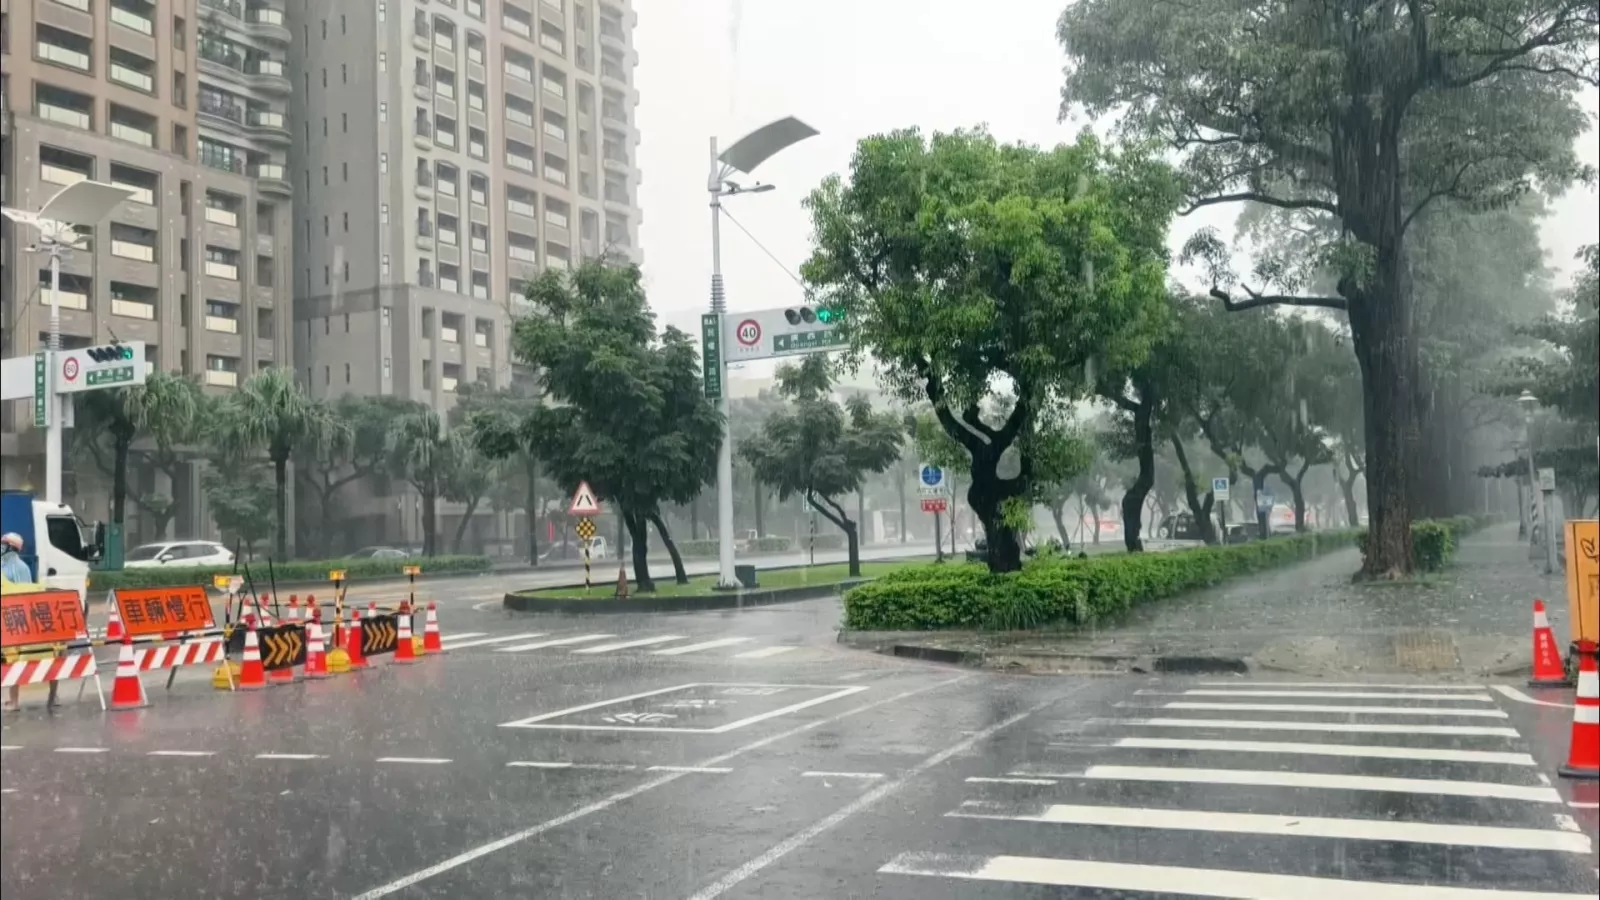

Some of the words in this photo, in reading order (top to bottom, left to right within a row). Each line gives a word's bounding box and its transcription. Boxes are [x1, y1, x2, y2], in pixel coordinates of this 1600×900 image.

[742, 327, 757, 339] 40
[2, 600, 79, 636] 輛慢行
[124, 593, 207, 626] 車輛慢行
